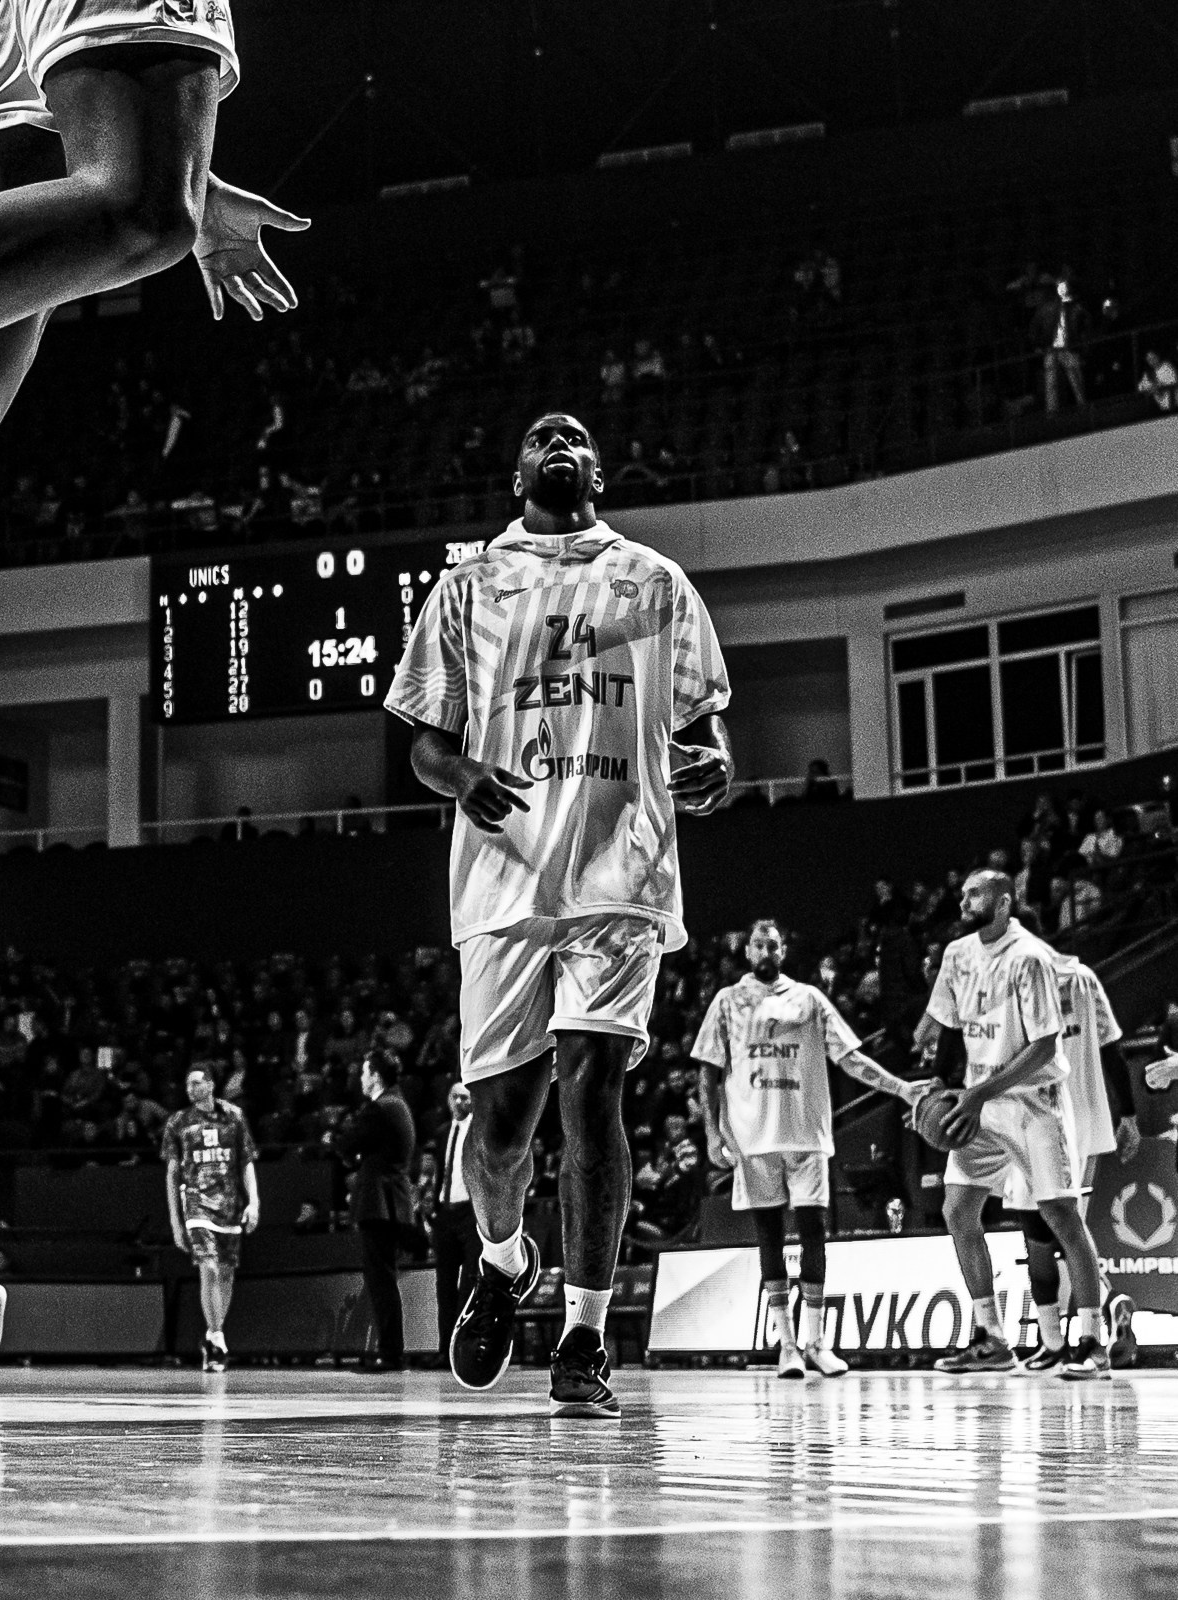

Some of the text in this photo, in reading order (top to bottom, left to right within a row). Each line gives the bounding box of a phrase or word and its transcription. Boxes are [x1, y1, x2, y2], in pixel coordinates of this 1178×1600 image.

[189, 564, 230, 588] UNICS
[335, 607, 345, 630] 1
[308, 635, 379, 668] 15:24
[546, 614, 597, 660] 24
[513, 671, 634, 711] ZENIT
[557, 752, 628, 782] ГАЗПРОМ
[747, 1043, 800, 1059] ZENIT
